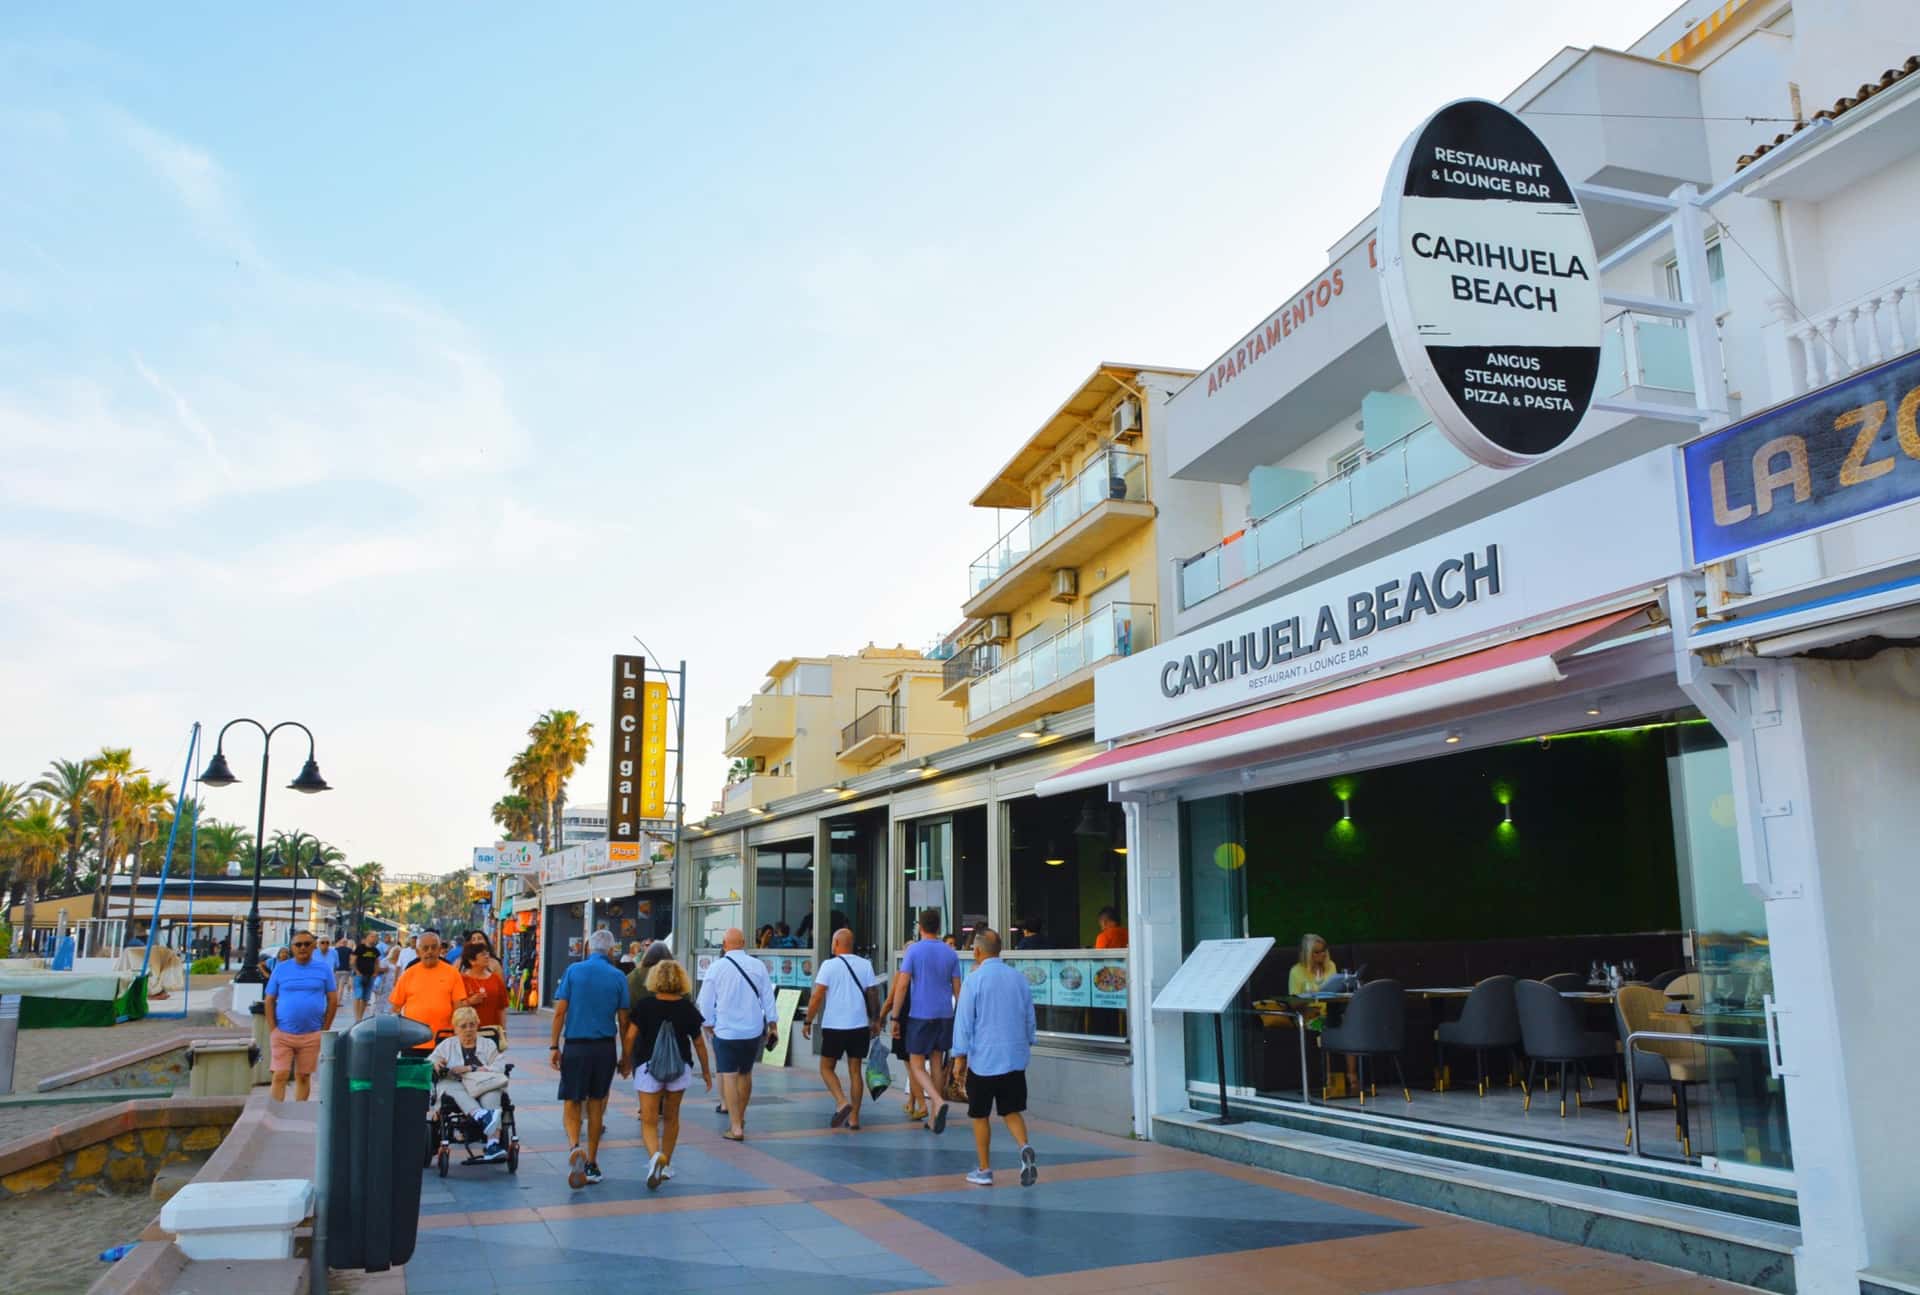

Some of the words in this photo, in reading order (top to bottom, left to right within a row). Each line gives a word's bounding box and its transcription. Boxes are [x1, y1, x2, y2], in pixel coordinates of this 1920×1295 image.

[1434, 147, 1542, 177] RESTAURANT
[1431, 169, 1440, 181] &
[1443, 168, 1512, 194] LOUNGE
[1515, 180, 1550, 199] BAR
[1411, 232, 1590, 281] CARIHUELA
[1451, 275, 1558, 313] BEACH
[1207, 268, 1344, 398] APARTAMENTOS
[1464, 368, 1567, 392] STEAKHOUSE
[1486, 352, 1541, 371] ANGUS
[1463, 387, 1510, 406] PIZZA
[1512, 395, 1521, 407] &
[1523, 394, 1575, 413] PASTA
[1708, 434, 1812, 527] LA
[1160, 604, 1342, 699] CARIHUELA
[1347, 543, 1502, 641] BEACH
[622, 661, 637, 700] La
[1248, 666, 1301, 690] RESTAURANT
[1309, 651, 1347, 673] LOUNGE
[1348, 645, 1370, 662] BAR
[617, 714, 637, 837] Cigala
